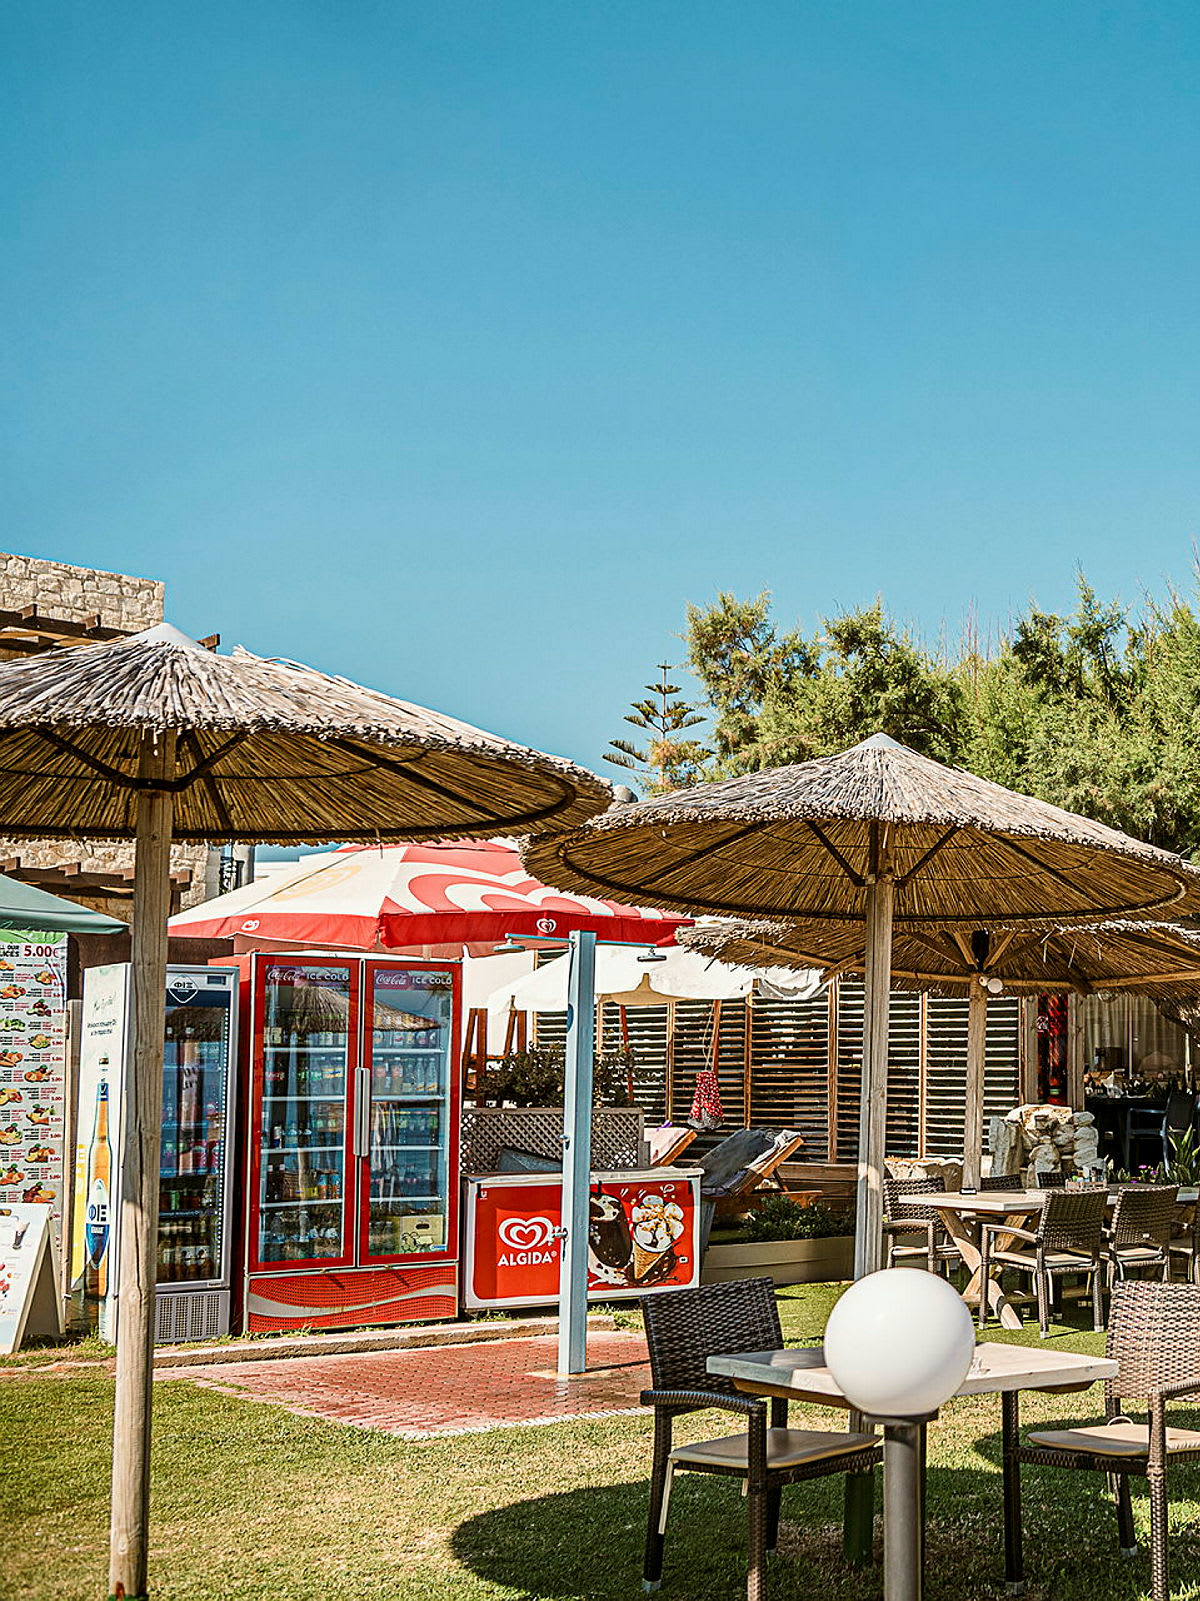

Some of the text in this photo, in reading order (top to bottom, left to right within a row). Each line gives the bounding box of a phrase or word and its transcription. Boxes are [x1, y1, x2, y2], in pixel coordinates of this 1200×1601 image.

[306, 972, 321, 980] ICE
[324, 973, 349, 981] COLD
[497, 1251, 553, 1266] ALGIDA
